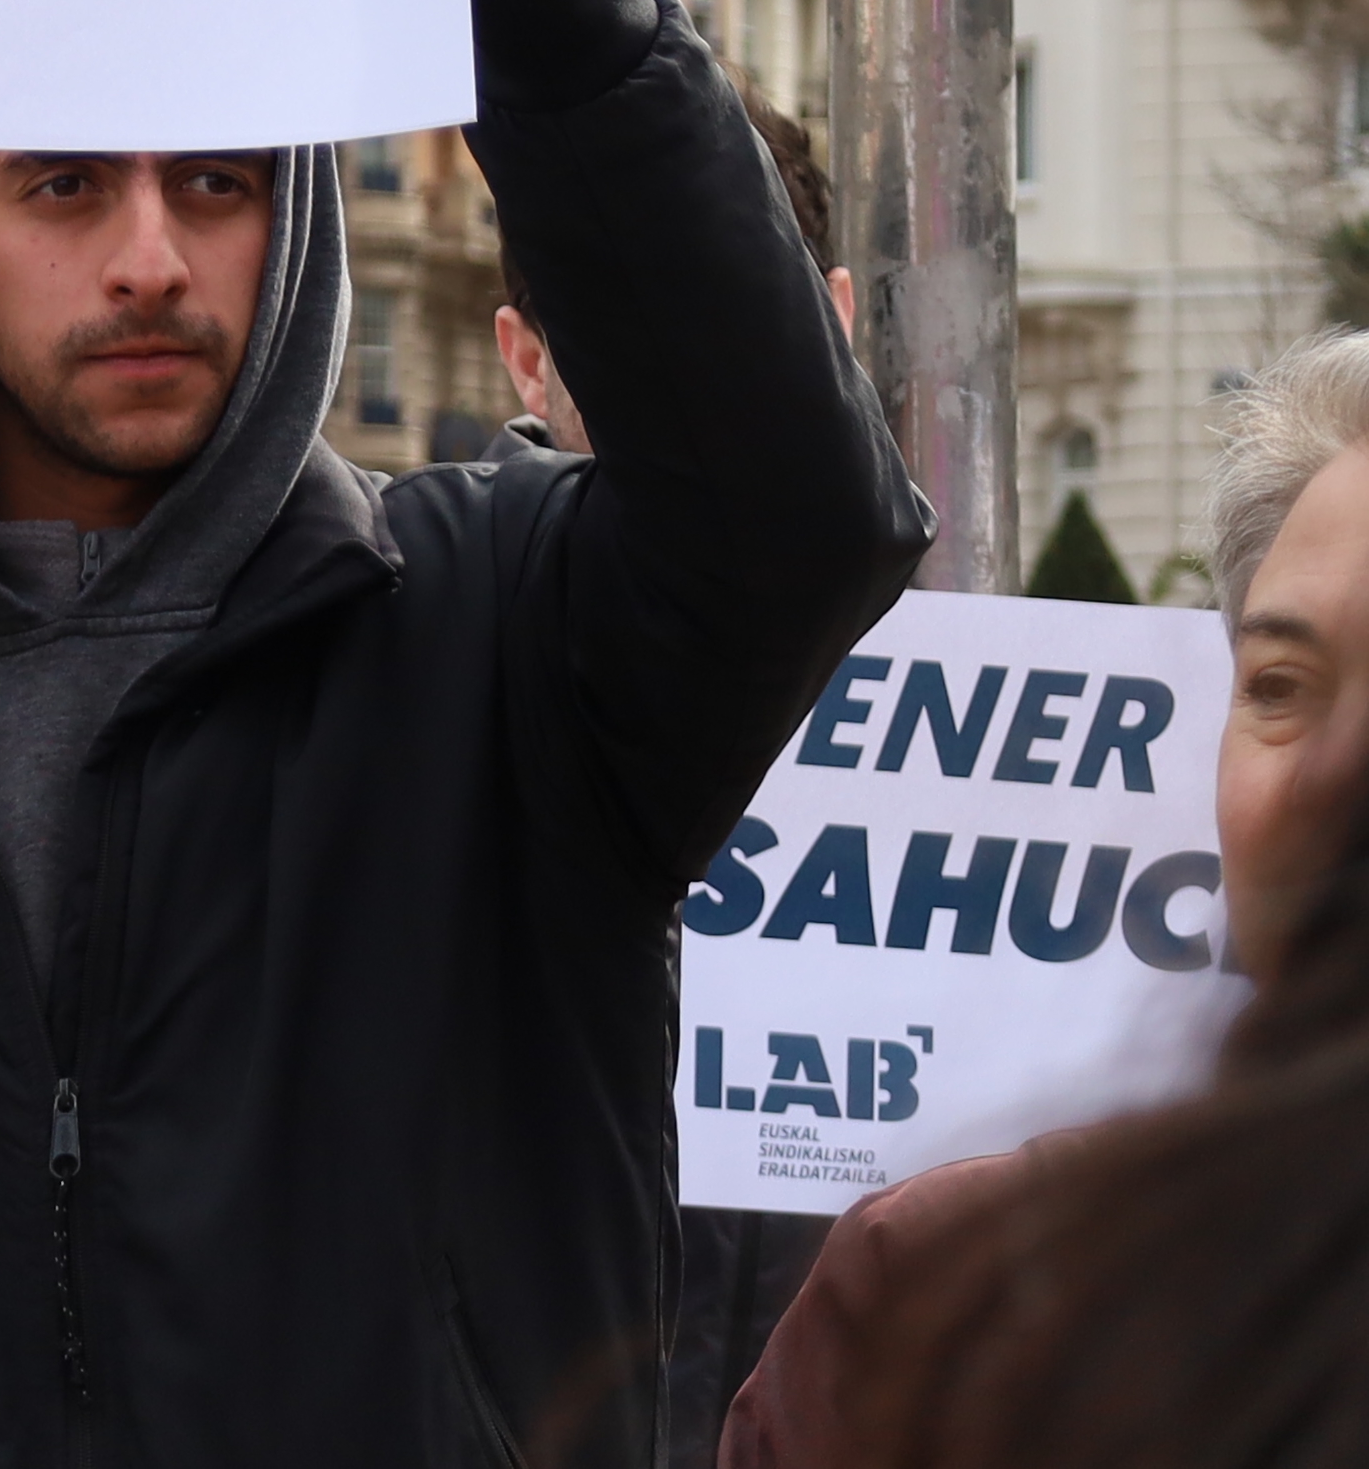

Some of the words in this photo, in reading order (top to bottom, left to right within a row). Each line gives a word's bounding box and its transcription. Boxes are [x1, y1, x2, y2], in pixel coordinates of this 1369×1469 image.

[795, 653, 1175, 794] ENER
[681, 814, 1237, 976] SAHUC
[694, 1024, 921, 1122] LAB
[758, 1141, 876, 1165] SINDIKALISMO
[759, 1122, 821, 1143] EUSKAL
[758, 1161, 887, 1186] ERALDATZAILEA
